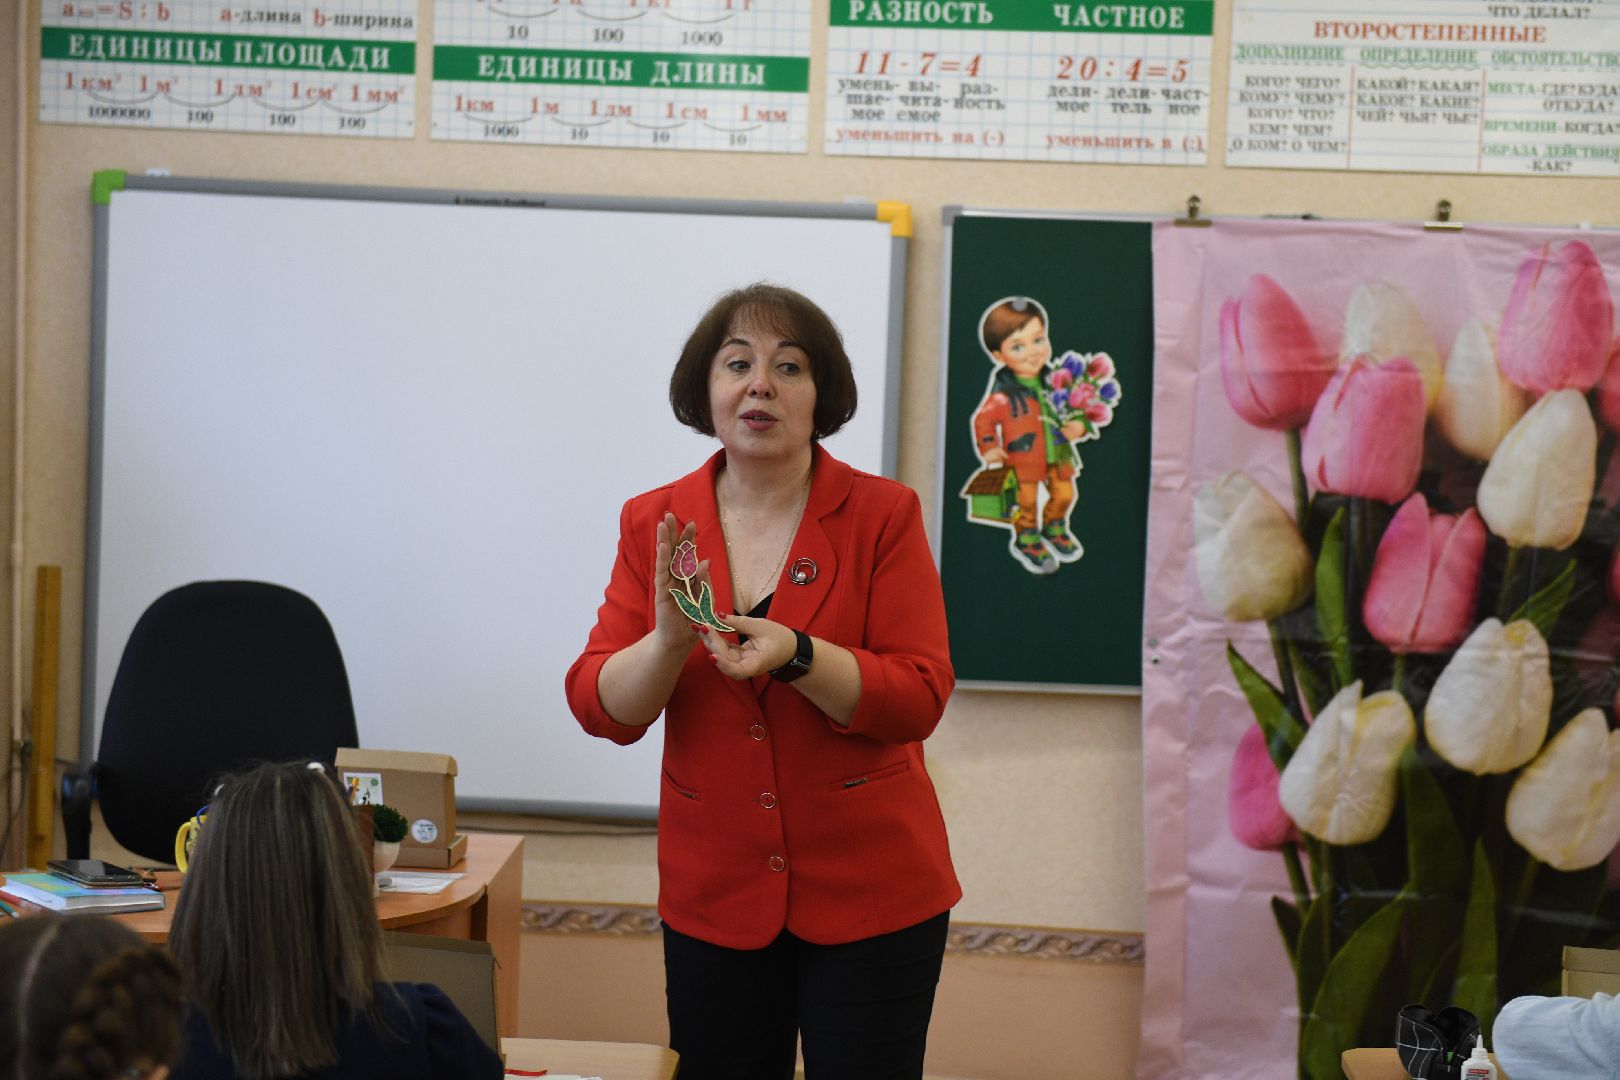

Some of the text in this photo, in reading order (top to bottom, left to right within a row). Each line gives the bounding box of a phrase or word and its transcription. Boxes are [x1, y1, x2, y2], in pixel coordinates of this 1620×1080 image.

[849, 1, 994, 24] РАЗНОСТЬ
[1053, 4, 1186, 29] ЧАСТНОЕ
[1488, 6, 1591, 19] ЧТО ДЕЛАЛ?
[508, 25, 723, 46] 10 100 1000
[1314, 21, 1546, 42] ВТОРОСТЕПЕННЫЕ
[69, 33, 391, 71] ЕДИНИЦЫ ПЛОЩАДИ
[1235, 44, 1345, 61] ДОПОЛНЕНИЕ
[1360, 46, 1478, 63] ОПРЕДЕЛЕНИЕ
[478, 55, 766, 86] ЕДИНИЦЫ ДЛИНЫ
[1245, 76, 1341, 90] КОГО? ЧЕГО?
[1357, 77, 1480, 92] КАКОЙ? КАКАЯ?
[1239, 91, 1345, 105] КОМУ? ЧЕМУ?
[1357, 94, 1480, 109] КАКОЕ? КАКИЕ?
[1543, 99, 1615, 113] ОТКУДА?
[852, 107, 942, 122] мое емое
[1056, 100, 1201, 116] мое тель ное
[1247, 107, 1336, 121] КОГО? ЧТО?
[1356, 108, 1395, 122] ЧЕЙ?
[1400, 110, 1437, 124] ЧЬЯ?
[187, 109, 213, 123] 100
[269, 113, 296, 127] 100
[339, 116, 366, 130] 100
[483, 124, 747, 146] 1000 10 10 10
[835, 127, 944, 144] уменьшить
[951, 130, 975, 144] на
[1248, 123, 1333, 137] КЕМ? ЧЕМ?
[1046, 135, 1155, 149] уменьшить
[1161, 136, 1173, 149] в
[1247, 139, 1288, 152] КОМ?
[1291, 140, 1302, 152] О
[1307, 141, 1347, 154] ЧЕМ?
[1481, 143, 1539, 157] ОБРАЗА
